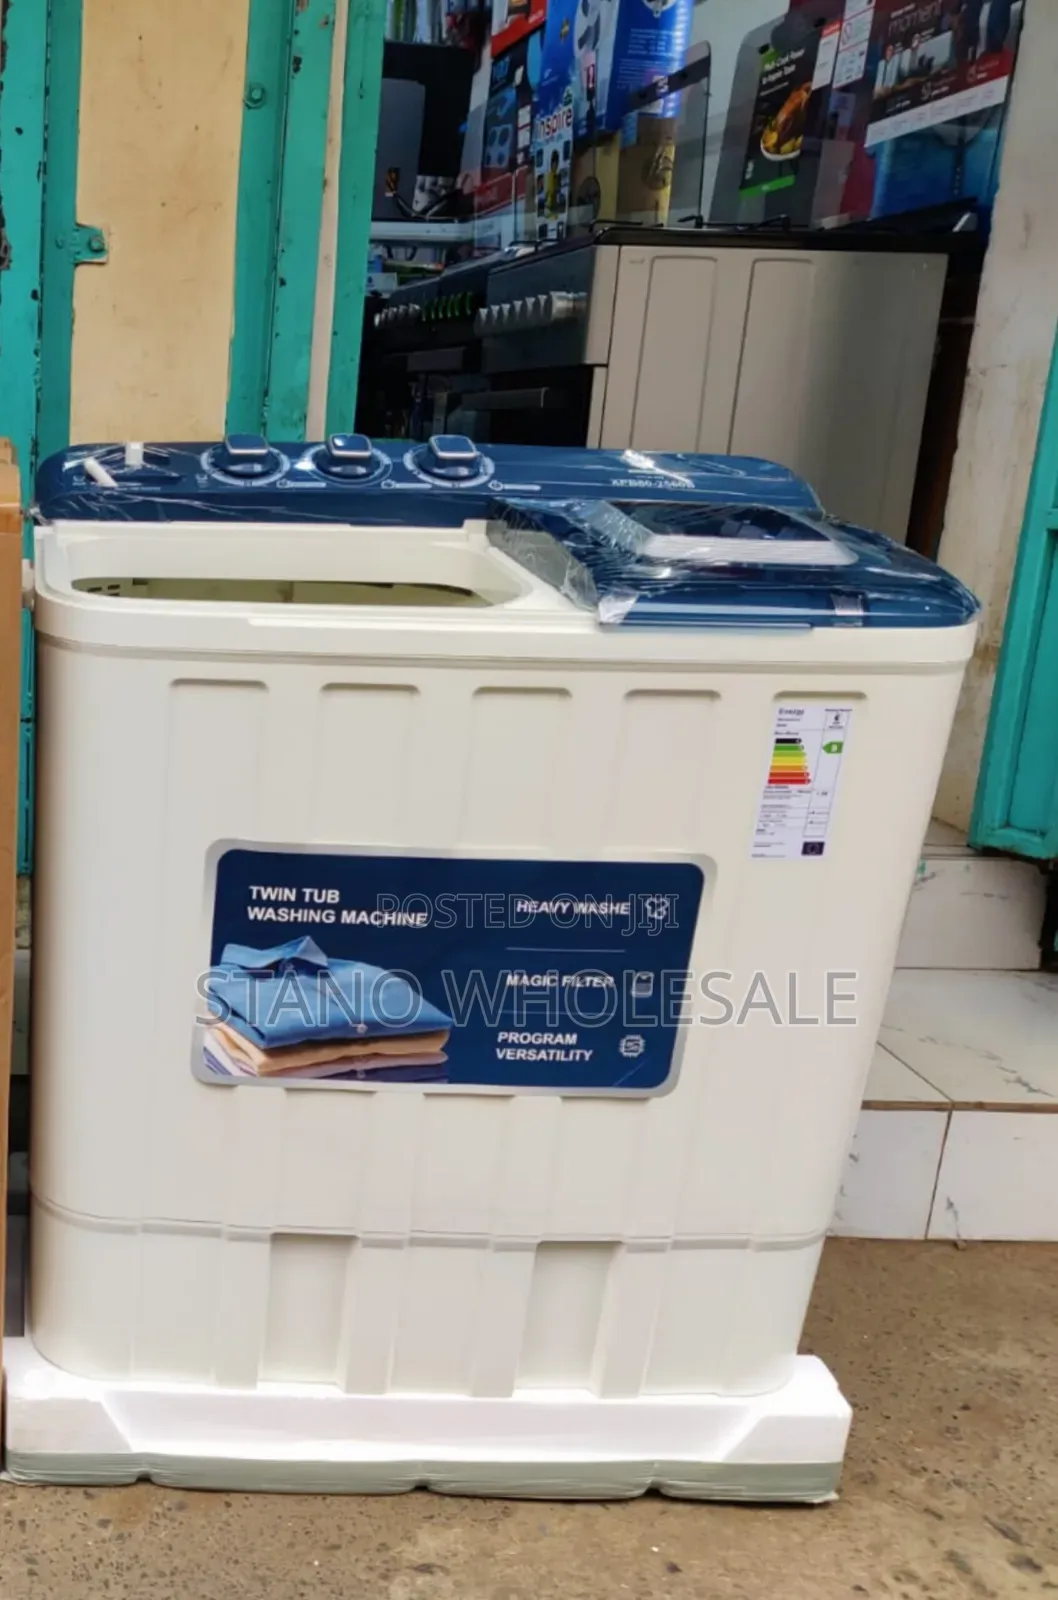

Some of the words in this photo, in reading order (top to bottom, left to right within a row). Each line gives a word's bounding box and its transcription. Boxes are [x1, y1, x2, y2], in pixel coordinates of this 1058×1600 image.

[249, 886, 297, 902] TWIN
[302, 888, 340, 904] TUB
[516, 900, 569, 914] HEAVY
[572, 902, 630, 915] WASHE
[247, 907, 336, 924] WASHING
[341, 911, 428, 927] MACHINE
[507, 975, 557, 988] MAGIC
[562, 976, 615, 988] FILTER
[497, 1032, 577, 1046] PROGRAM
[496, 1048, 593, 1062] VERSATILITY
